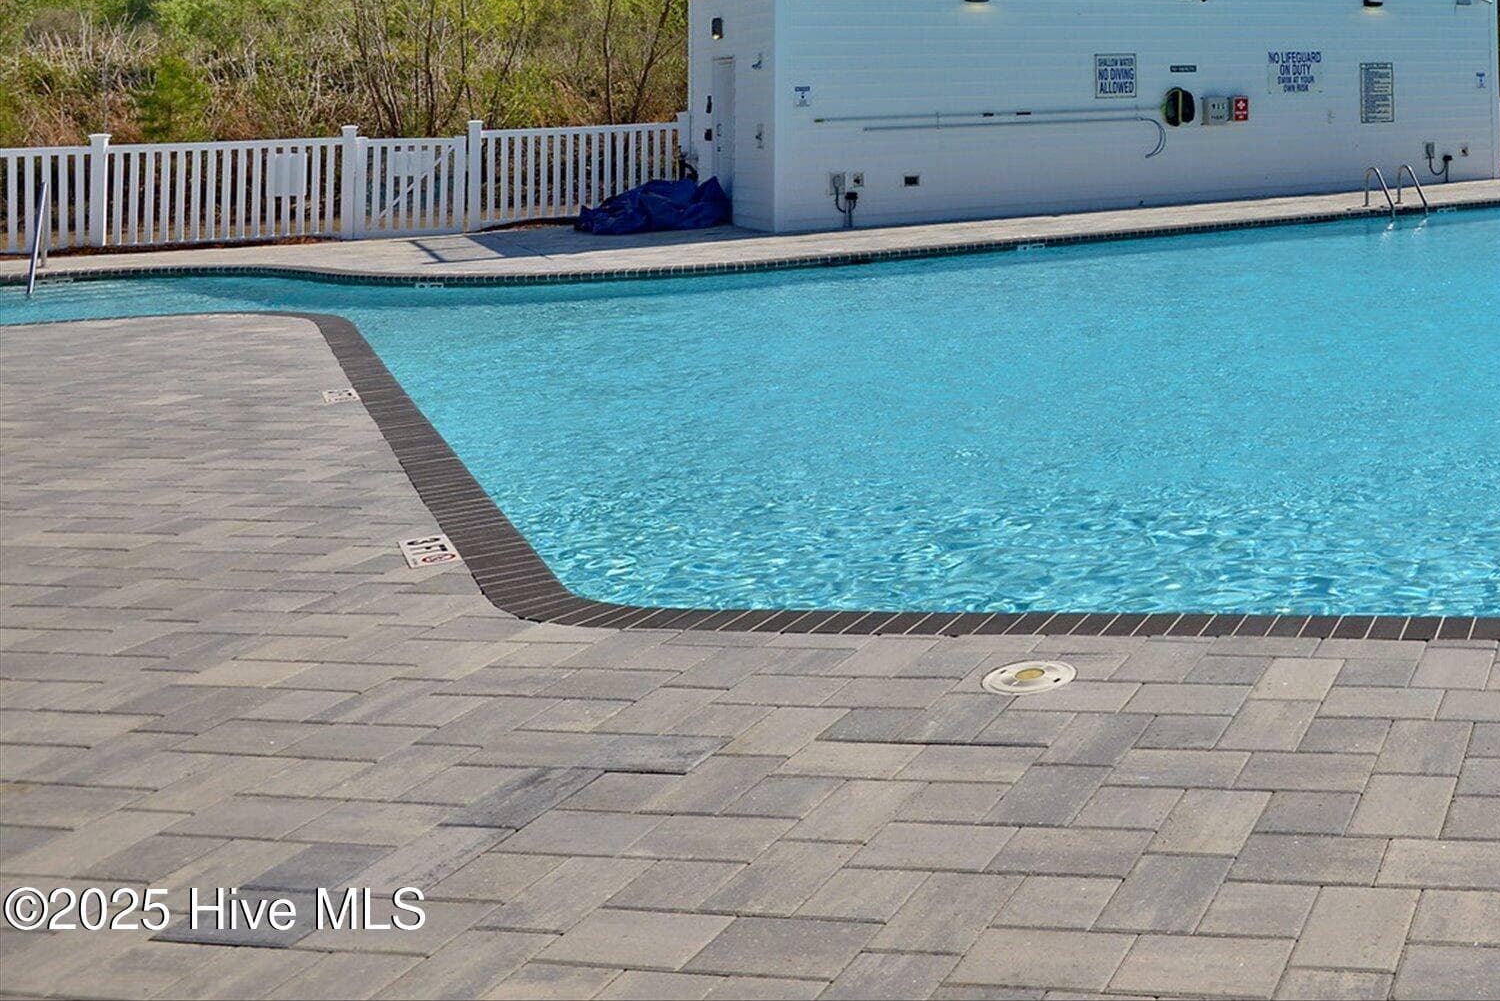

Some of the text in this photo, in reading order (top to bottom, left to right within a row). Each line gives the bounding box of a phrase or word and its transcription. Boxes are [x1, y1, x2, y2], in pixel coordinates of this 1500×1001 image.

[1268, 51, 1322, 64] NO LIFEGUARD
[1098, 68, 1134, 81] NO DIVING
[1279, 64, 1312, 76] ON DUTY
[1099, 81, 1134, 94] ALLOWED
